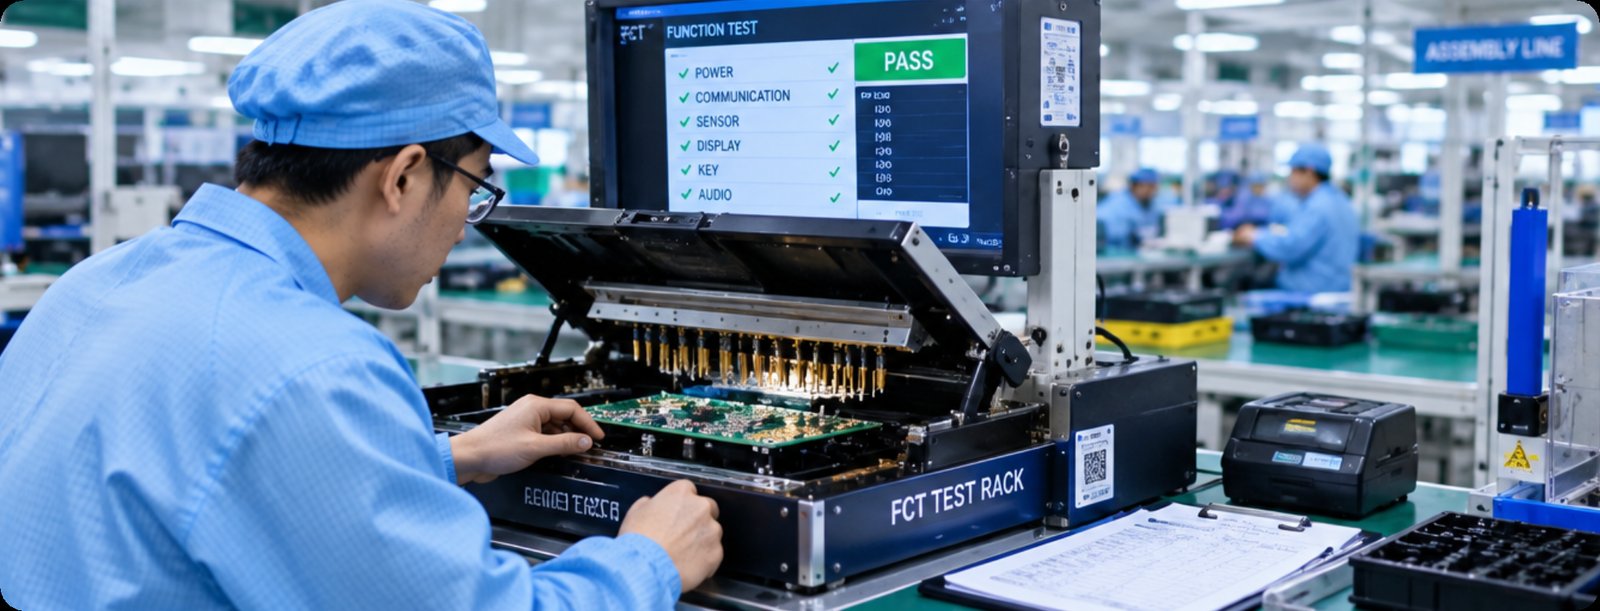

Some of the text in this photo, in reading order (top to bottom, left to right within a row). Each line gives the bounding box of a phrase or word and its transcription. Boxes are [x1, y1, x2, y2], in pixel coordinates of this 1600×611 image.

[666, 20, 759, 39] FUNCTION TEST
[1425, 34, 1565, 62] ASSEMBLY LINE
[884, 49, 934, 72] PASS
[695, 66, 734, 79] POWER
[695, 89, 791, 104] COMMUNICATION
[696, 115, 740, 128] SENSOR
[697, 139, 741, 152] DISPLAY
[698, 164, 719, 176] KEY
[698, 188, 733, 201] AUDIO
[891, 467, 1025, 526] FCT TEST RACK
